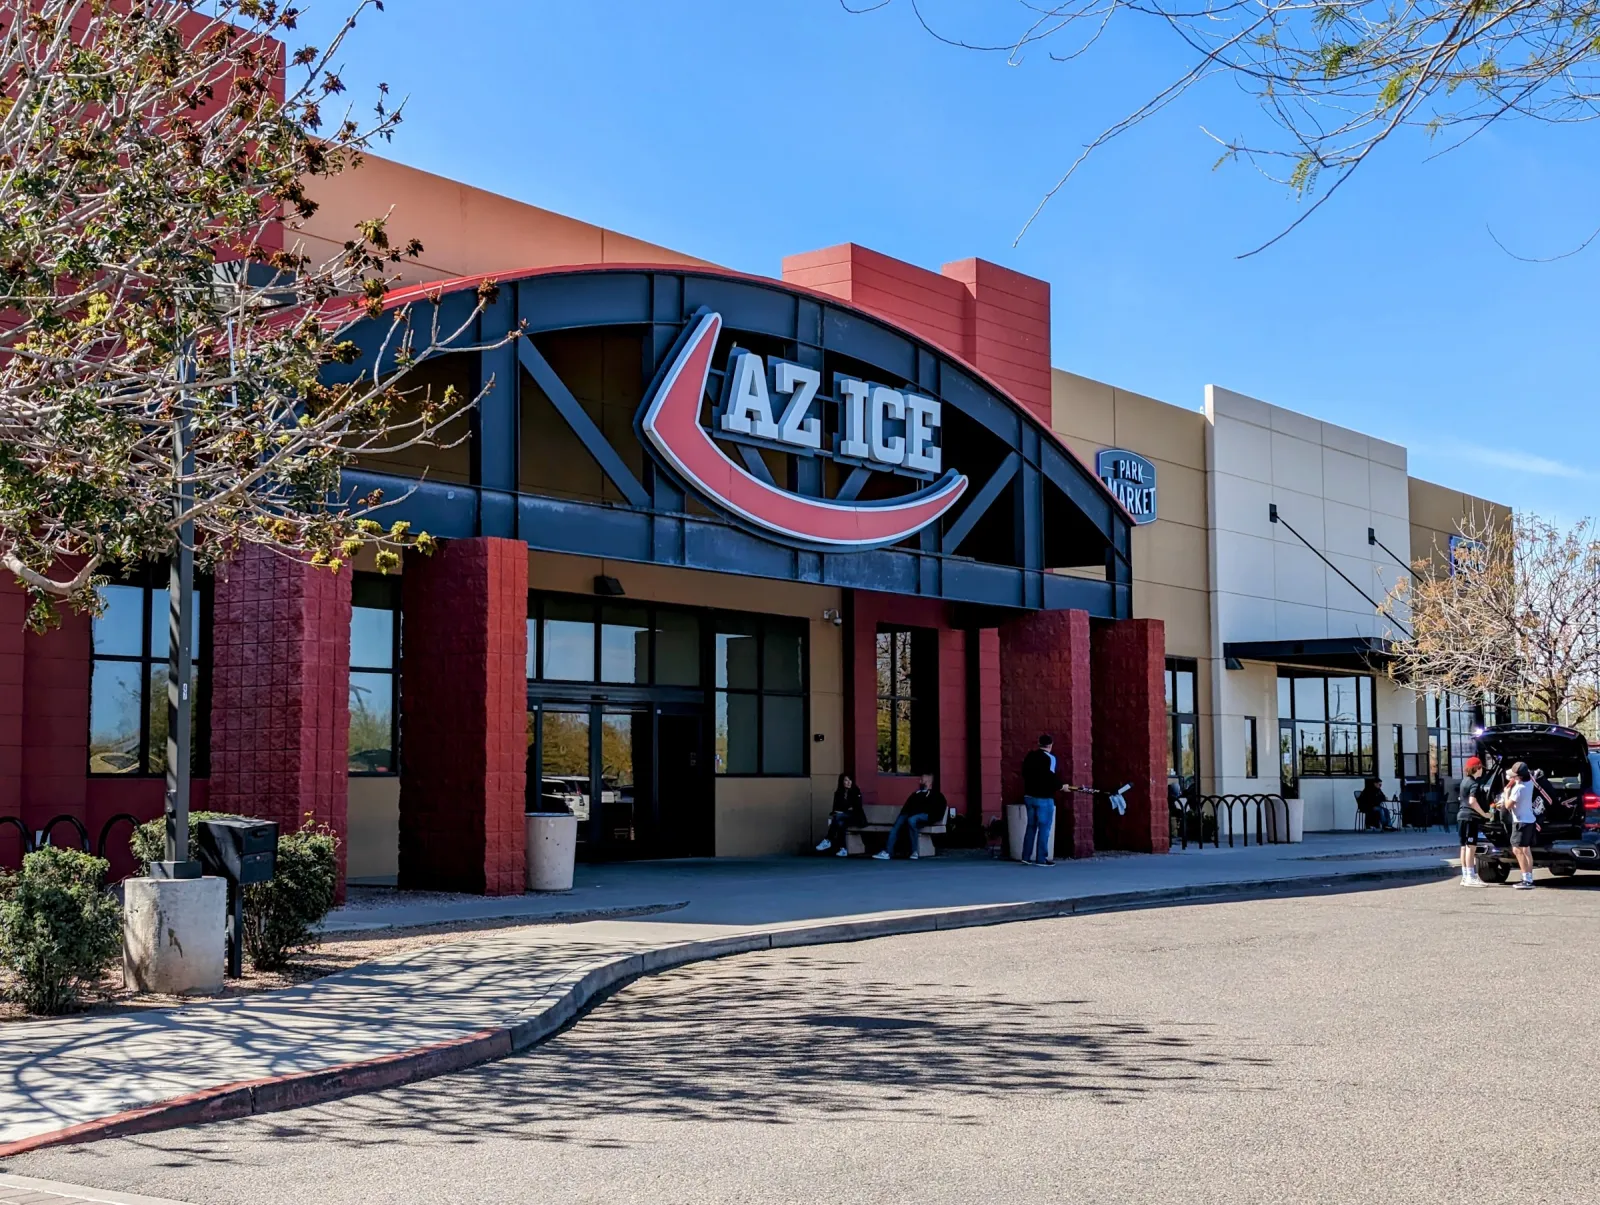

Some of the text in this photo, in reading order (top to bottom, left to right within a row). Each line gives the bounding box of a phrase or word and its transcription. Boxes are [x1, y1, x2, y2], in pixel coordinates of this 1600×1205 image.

[720, 352, 942, 474] AZ ICE
[1119, 459, 1144, 484] PARK
